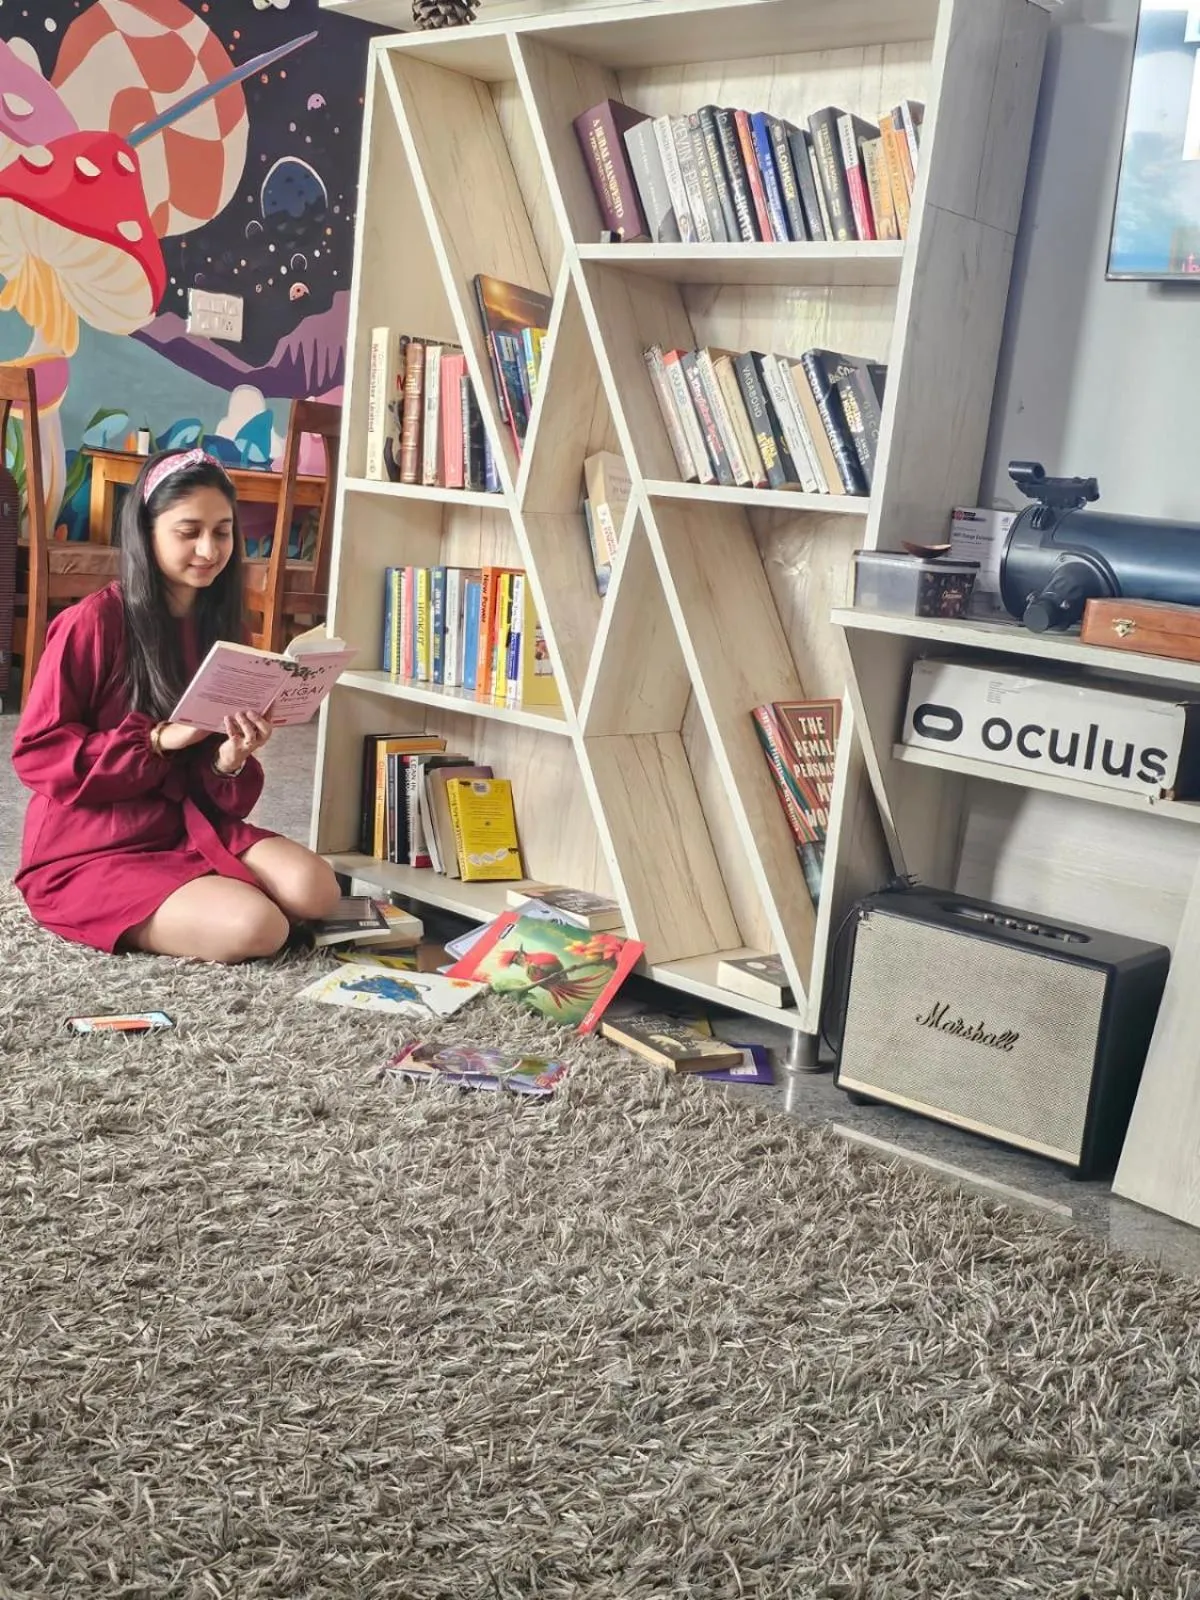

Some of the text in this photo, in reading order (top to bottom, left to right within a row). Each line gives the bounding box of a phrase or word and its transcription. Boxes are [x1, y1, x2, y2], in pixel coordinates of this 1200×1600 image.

[671, 117, 692, 161] KEVIN
[775, 143, 790, 172] ELON
[592, 118, 625, 219] A RURAL MANIFESTO
[699, 167, 715, 202] WARNE
[781, 171, 795, 201] MUSK
[368, 343, 378, 432] Manchester United
[740, 364, 763, 418] VAGABOND
[416, 601, 425, 645] HOOKED
[480, 596, 488, 623] Power
[798, 717, 826, 734] THE
[793, 763, 836, 778] PERSUAS
[981, 717, 1169, 784] oculus
[915, 1001, 1020, 1052] Marshall
